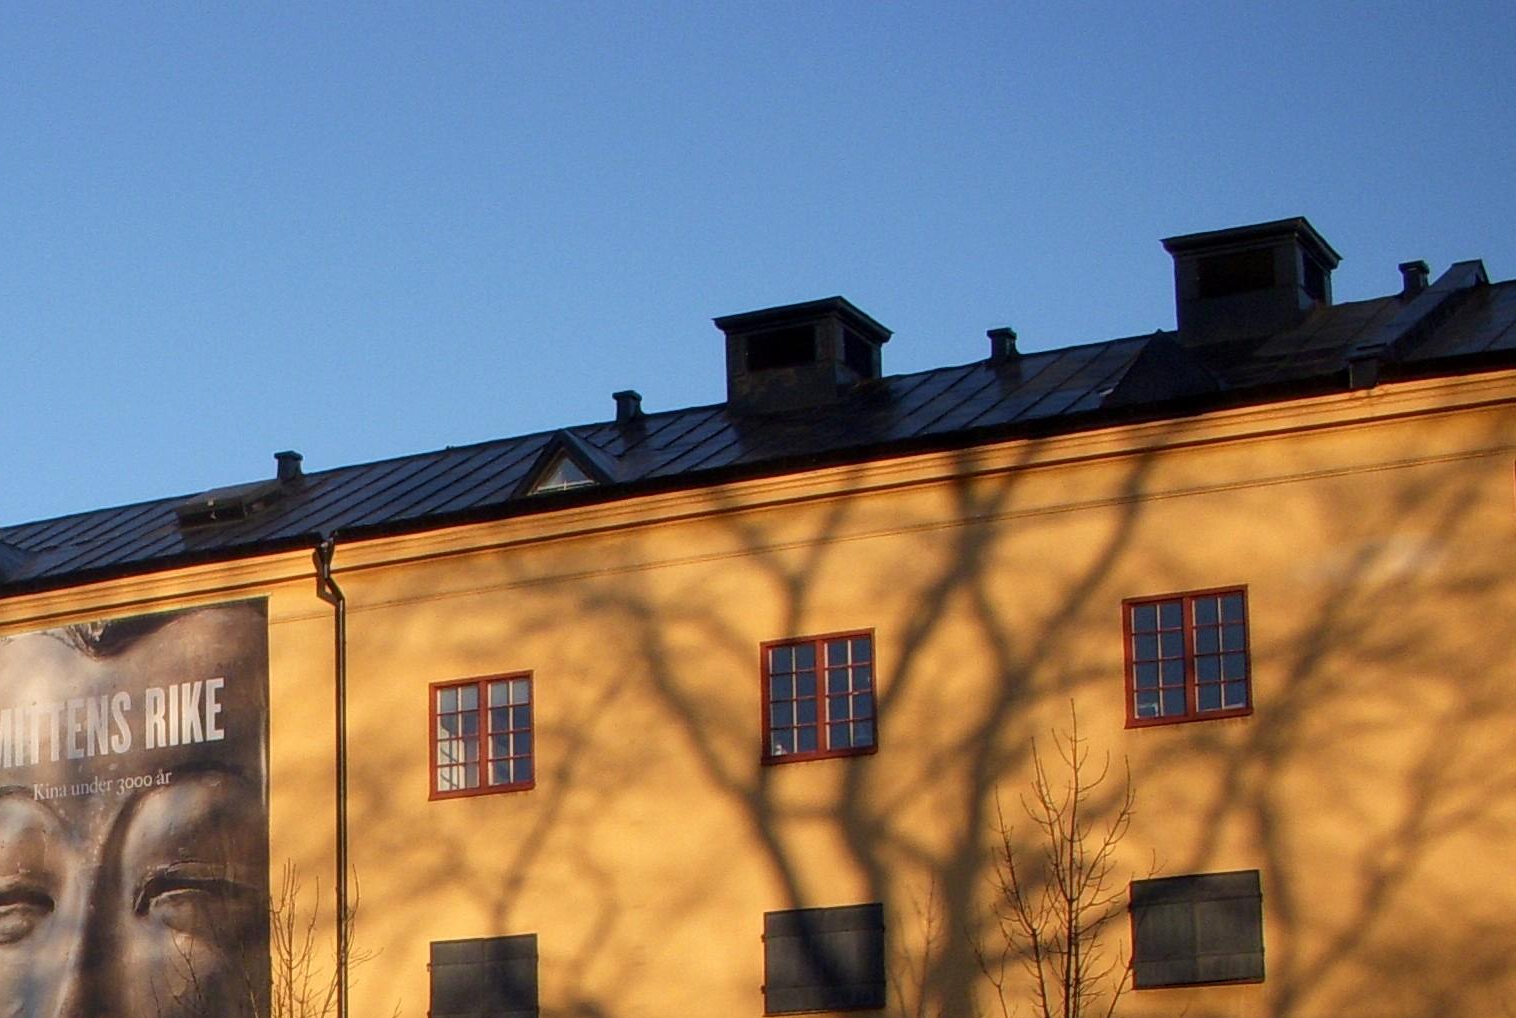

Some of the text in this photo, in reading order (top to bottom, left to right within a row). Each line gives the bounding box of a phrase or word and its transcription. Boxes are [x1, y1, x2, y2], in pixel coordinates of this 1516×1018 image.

[145, 677, 226, 750] RIKE
[33, 768, 173, 800] Kina under 3000 år
